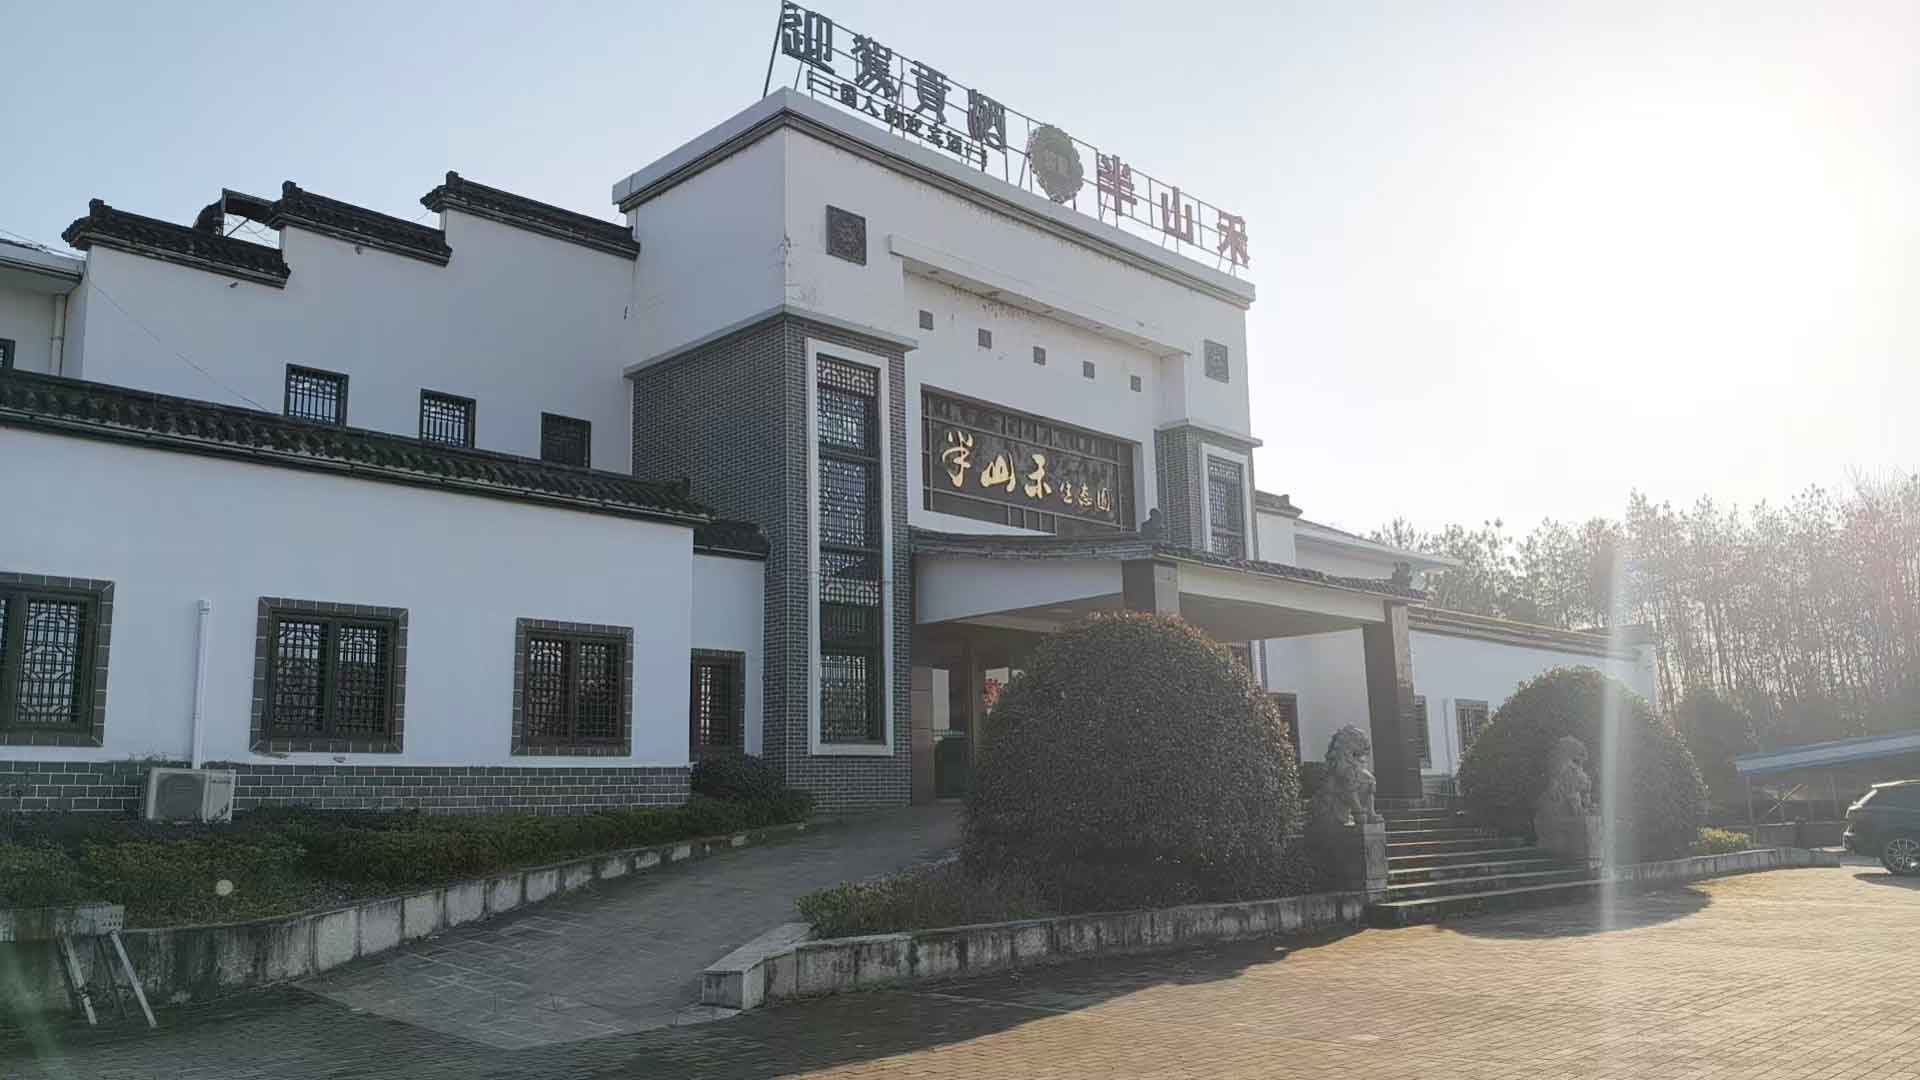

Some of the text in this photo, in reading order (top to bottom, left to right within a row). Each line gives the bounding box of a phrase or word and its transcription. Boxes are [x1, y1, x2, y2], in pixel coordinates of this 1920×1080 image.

[1097, 154, 1249, 268] 半山禾
[942, 430, 1052, 499] 半山禾
